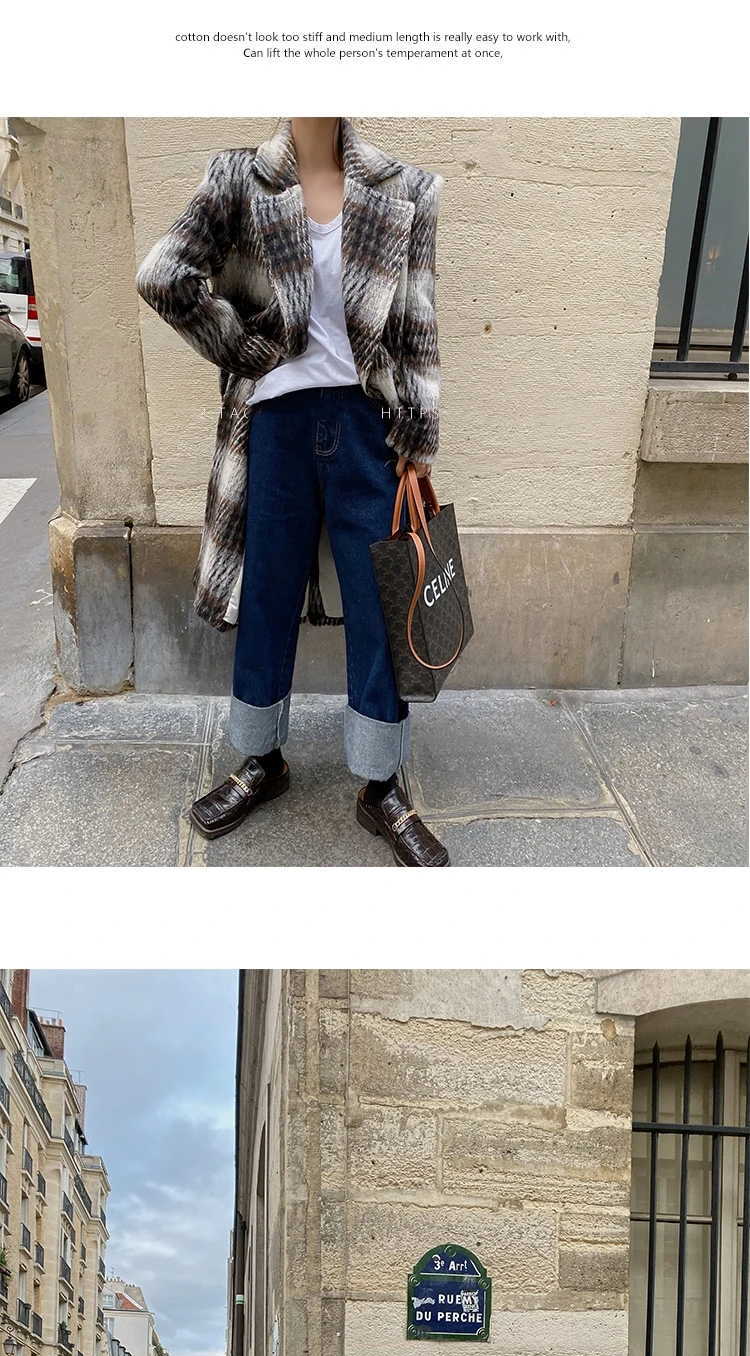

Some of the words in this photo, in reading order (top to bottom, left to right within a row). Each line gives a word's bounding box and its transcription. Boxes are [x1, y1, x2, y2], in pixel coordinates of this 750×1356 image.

[423, 557, 456, 607] CELINE
[438, 1294, 462, 1305] RUE
[416, 1311, 431, 1321] DU
[437, 1312, 483, 1323] PERCHE
